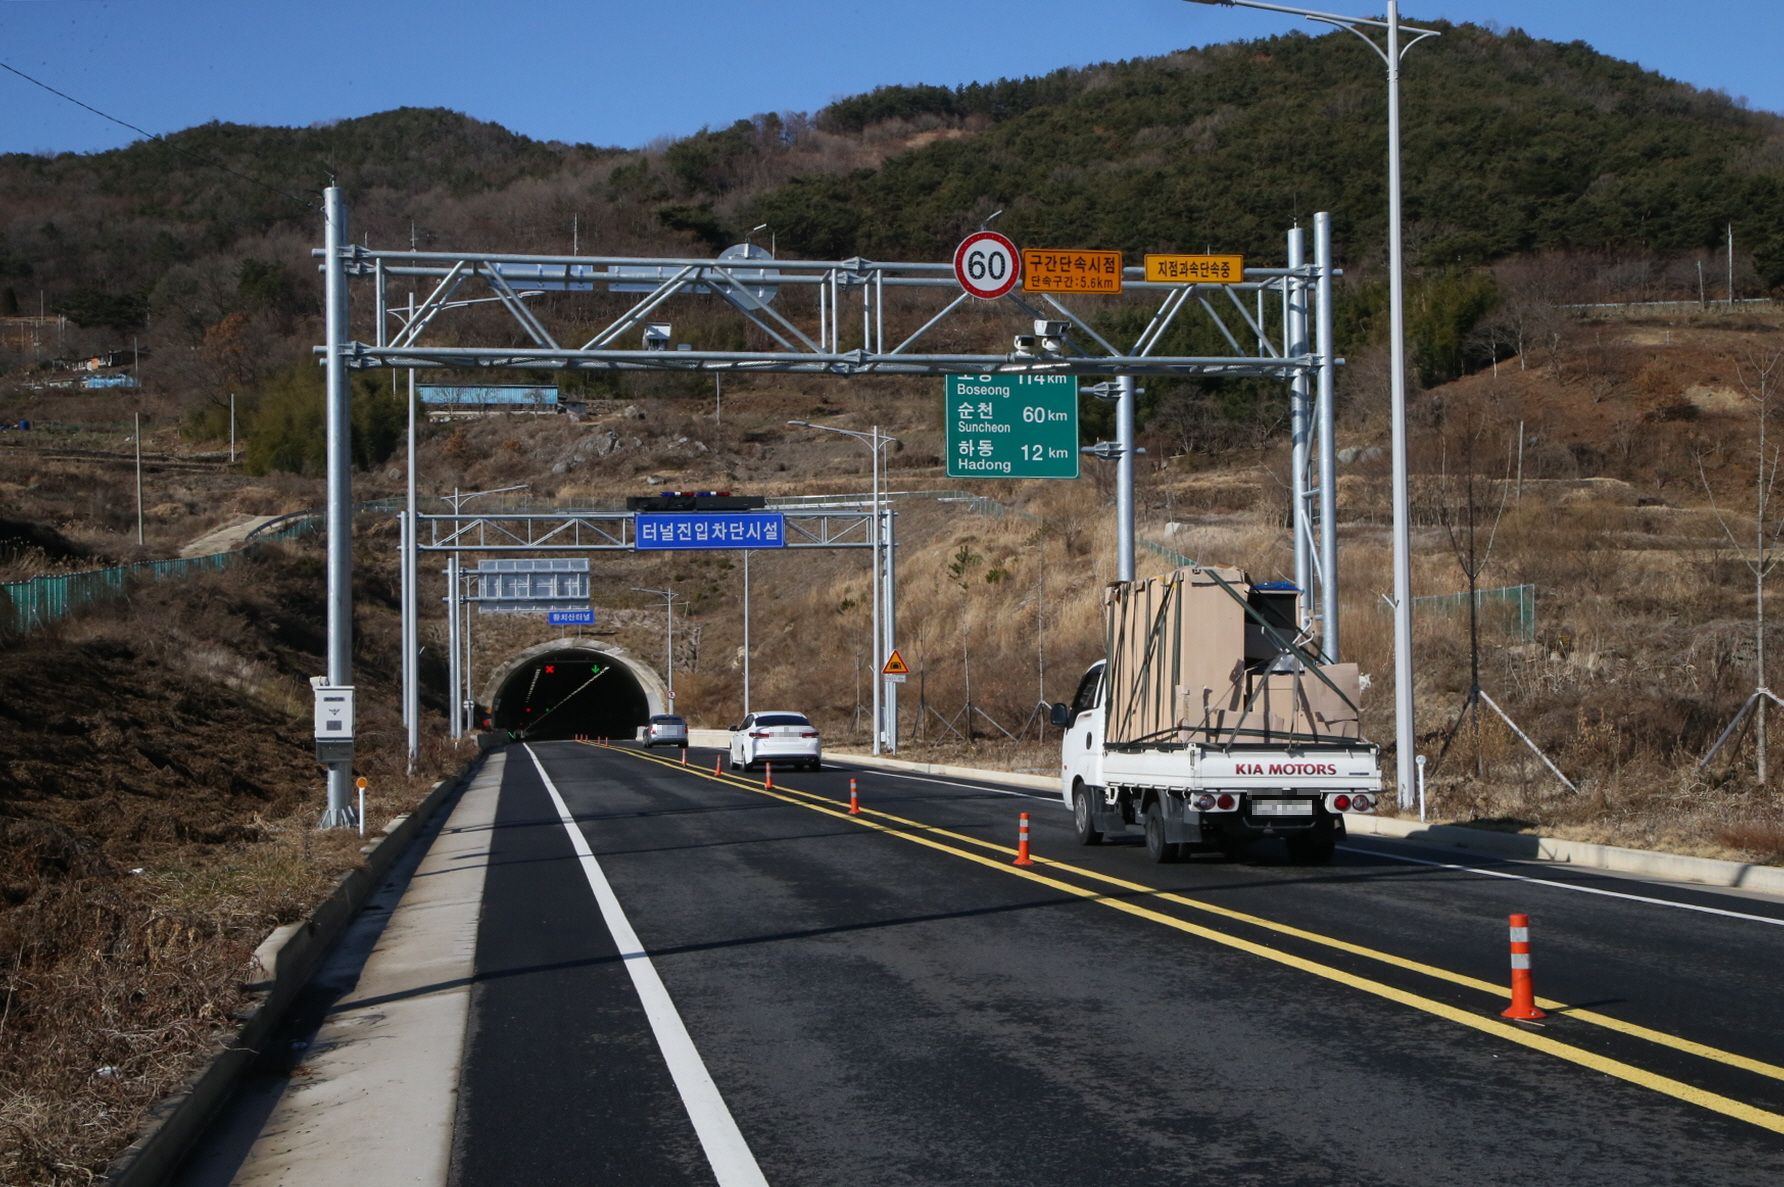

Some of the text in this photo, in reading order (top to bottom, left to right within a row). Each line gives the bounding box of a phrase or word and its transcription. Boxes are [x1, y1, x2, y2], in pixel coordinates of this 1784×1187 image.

[968, 251, 1006, 280] 60
[1029, 254, 1115, 274] 구간단속시점
[1158, 260, 1231, 278] 지점과속단속중
[957, 383, 1010, 398] Boseong
[957, 402, 1068, 423] 순천 60 km
[958, 420, 1011, 433] Suncheon
[958, 439, 1069, 461] 하동 12 km
[958, 458, 1011, 473] Hadong
[642, 521, 778, 541] 터널진입차단시설
[1235, 763, 1337, 775] KIA MOTORS
